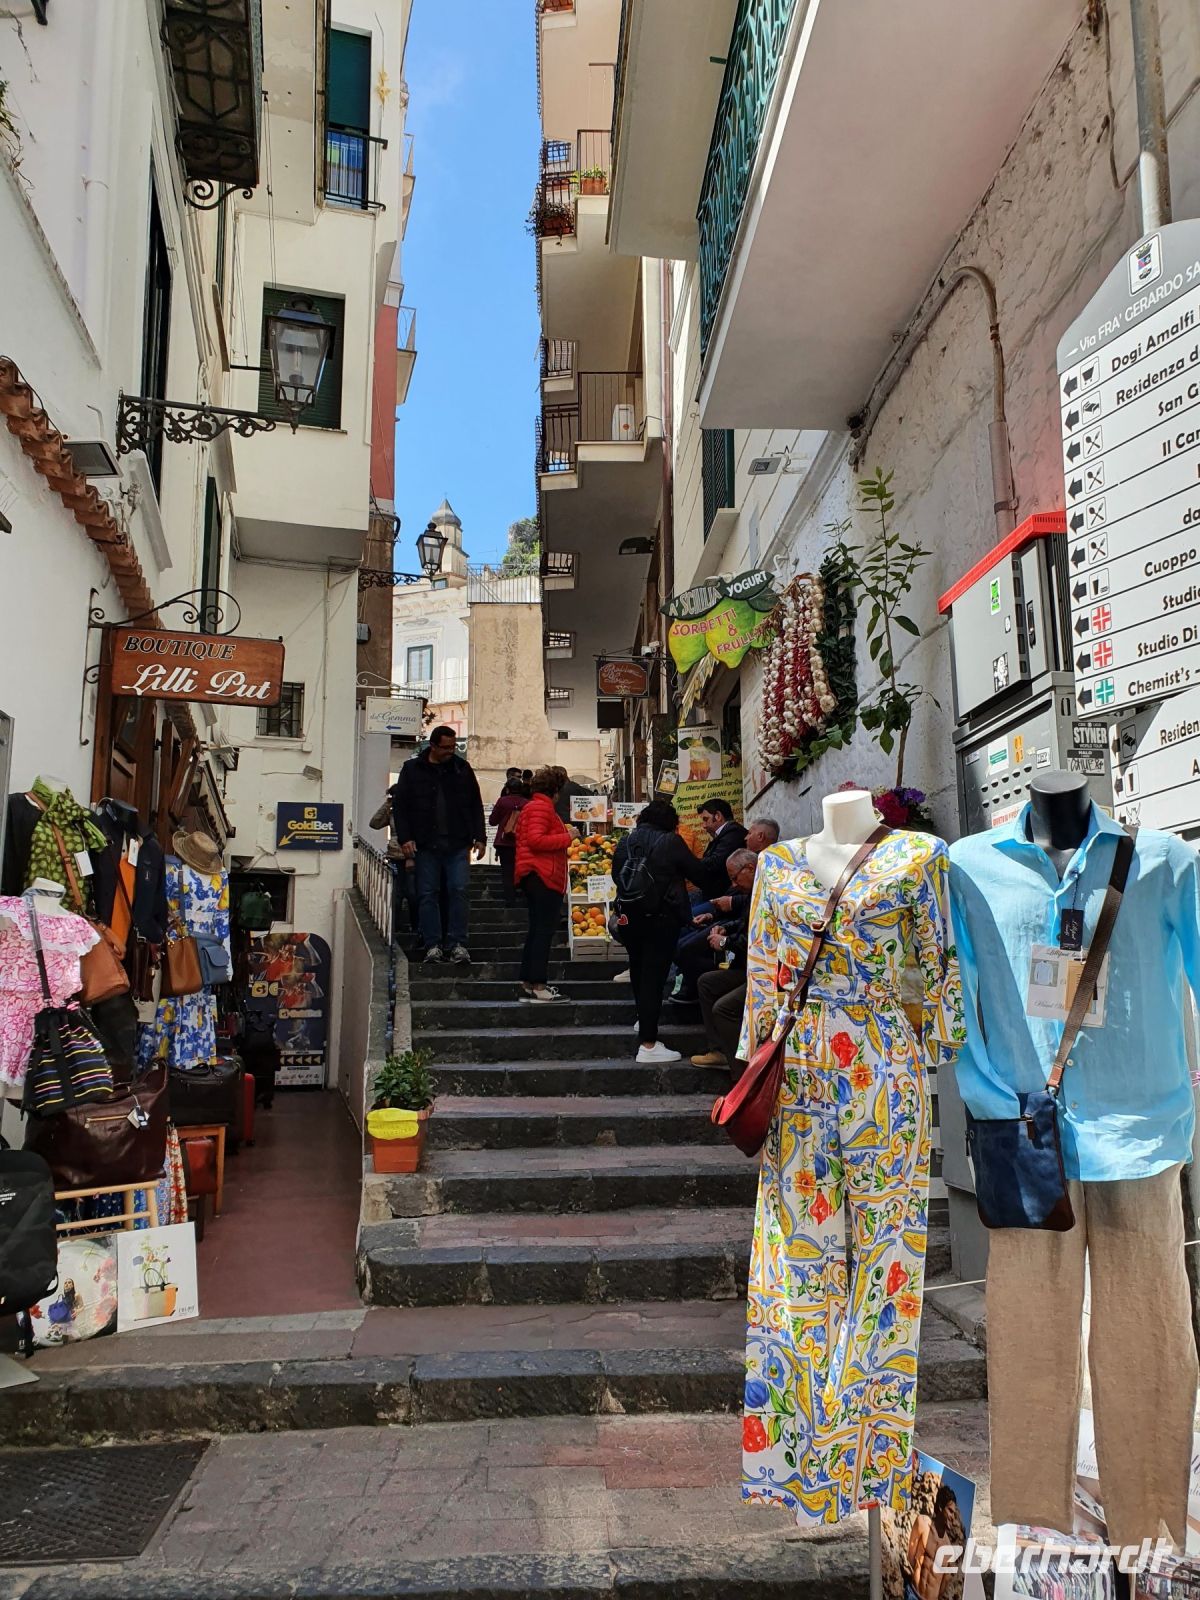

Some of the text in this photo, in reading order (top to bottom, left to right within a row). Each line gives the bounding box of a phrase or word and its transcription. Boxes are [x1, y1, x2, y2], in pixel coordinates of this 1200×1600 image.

[1079, 335, 1097, 352] Via
[1098, 312, 1123, 341] FRA'
[1124, 272, 1184, 322] GERARDO
[1111, 309, 1194, 373] Dogi Amalfi
[1116, 357, 1185, 406] Residenza
[1158, 395, 1183, 417] San
[1144, 548, 1197, 577] Cuoppo
[726, 571, 768, 596] YOGURT
[673, 608, 737, 636] SORBETTI
[727, 623, 738, 637] &
[123, 635, 237, 661] BOUTIQUE
[716, 621, 768, 655] FRULL
[1137, 634, 1179, 658] Studio
[121, 663, 271, 700] Lilli Put
[1127, 667, 1191, 697] Chemist's
[1073, 727, 1108, 744] STYNER
[288, 820, 334, 831] GoldBet
